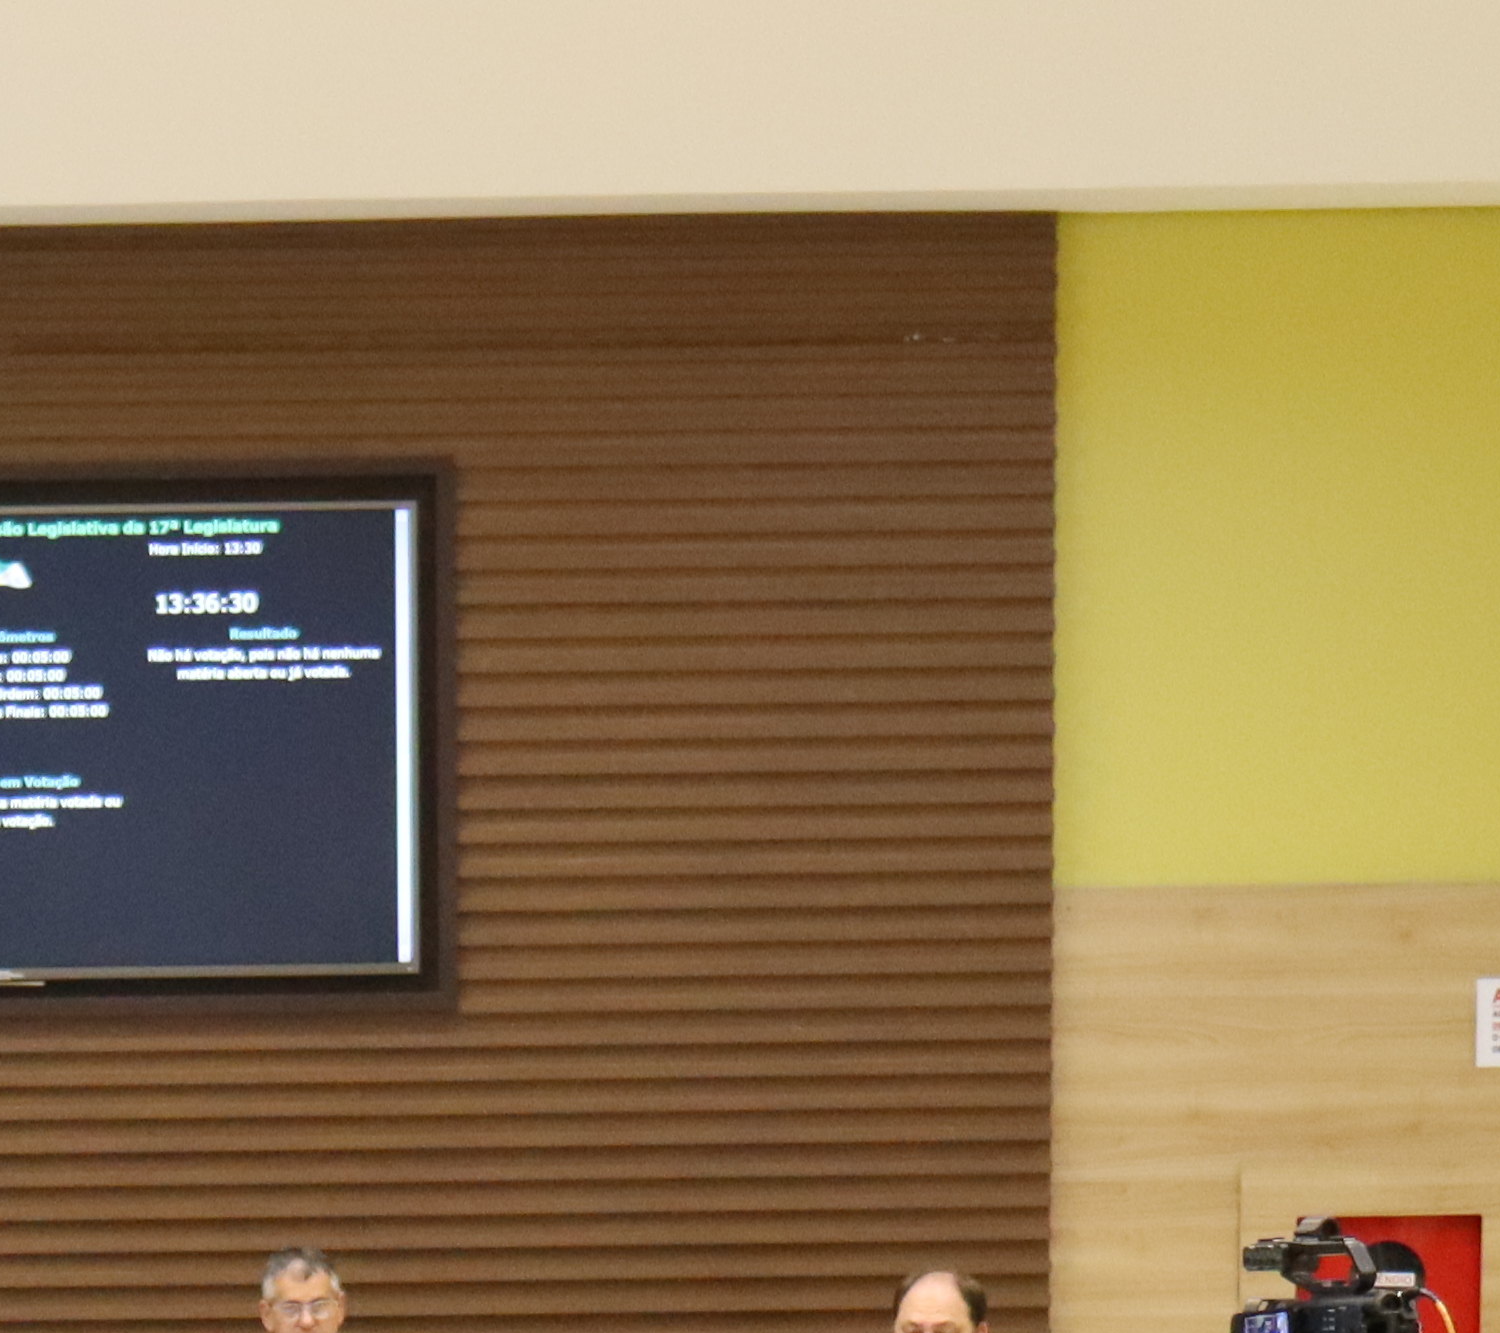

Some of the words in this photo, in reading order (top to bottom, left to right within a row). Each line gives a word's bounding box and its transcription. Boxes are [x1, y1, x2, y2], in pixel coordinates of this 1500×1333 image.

[27, 520, 120, 539] Legislativa
[123, 520, 146, 535] da
[148, 520, 180, 535] 17ª
[183, 519, 281, 537] Legislatura
[148, 542, 180, 556] Hora
[224, 540, 263, 555] 13:30
[155, 590, 260, 615] 13:36:30
[229, 626, 300, 640] Resultado
[10, 649, 72, 664] 00:05:00
[147, 646, 174, 662] Não
[175, 647, 193, 662] há
[194, 646, 247, 663] votação,
[249, 647, 276, 663] pois
[277, 646, 300, 660] não
[303, 647, 320, 660] há
[322, 646, 382, 660] nenhuma
[6, 667, 67, 683] 00:05:00
[176, 665, 225, 681] matéria
[227, 665, 269, 680] aberta
[270, 667, 287, 679] ou
[288, 665, 304, 681] já
[305, 664, 352, 679] votada.
[42, 685, 104, 700] 00:05:00
[5, 705, 47, 719] Finais:
[48, 703, 109, 718] 00:05:00
[0, 777, 23, 789] em
[24, 774, 81, 790] Votação
[10, 795, 59, 810] matéria
[60, 794, 103, 808] votada
[104, 795, 124, 808] ou
[2, 813, 55, 830] votação.
